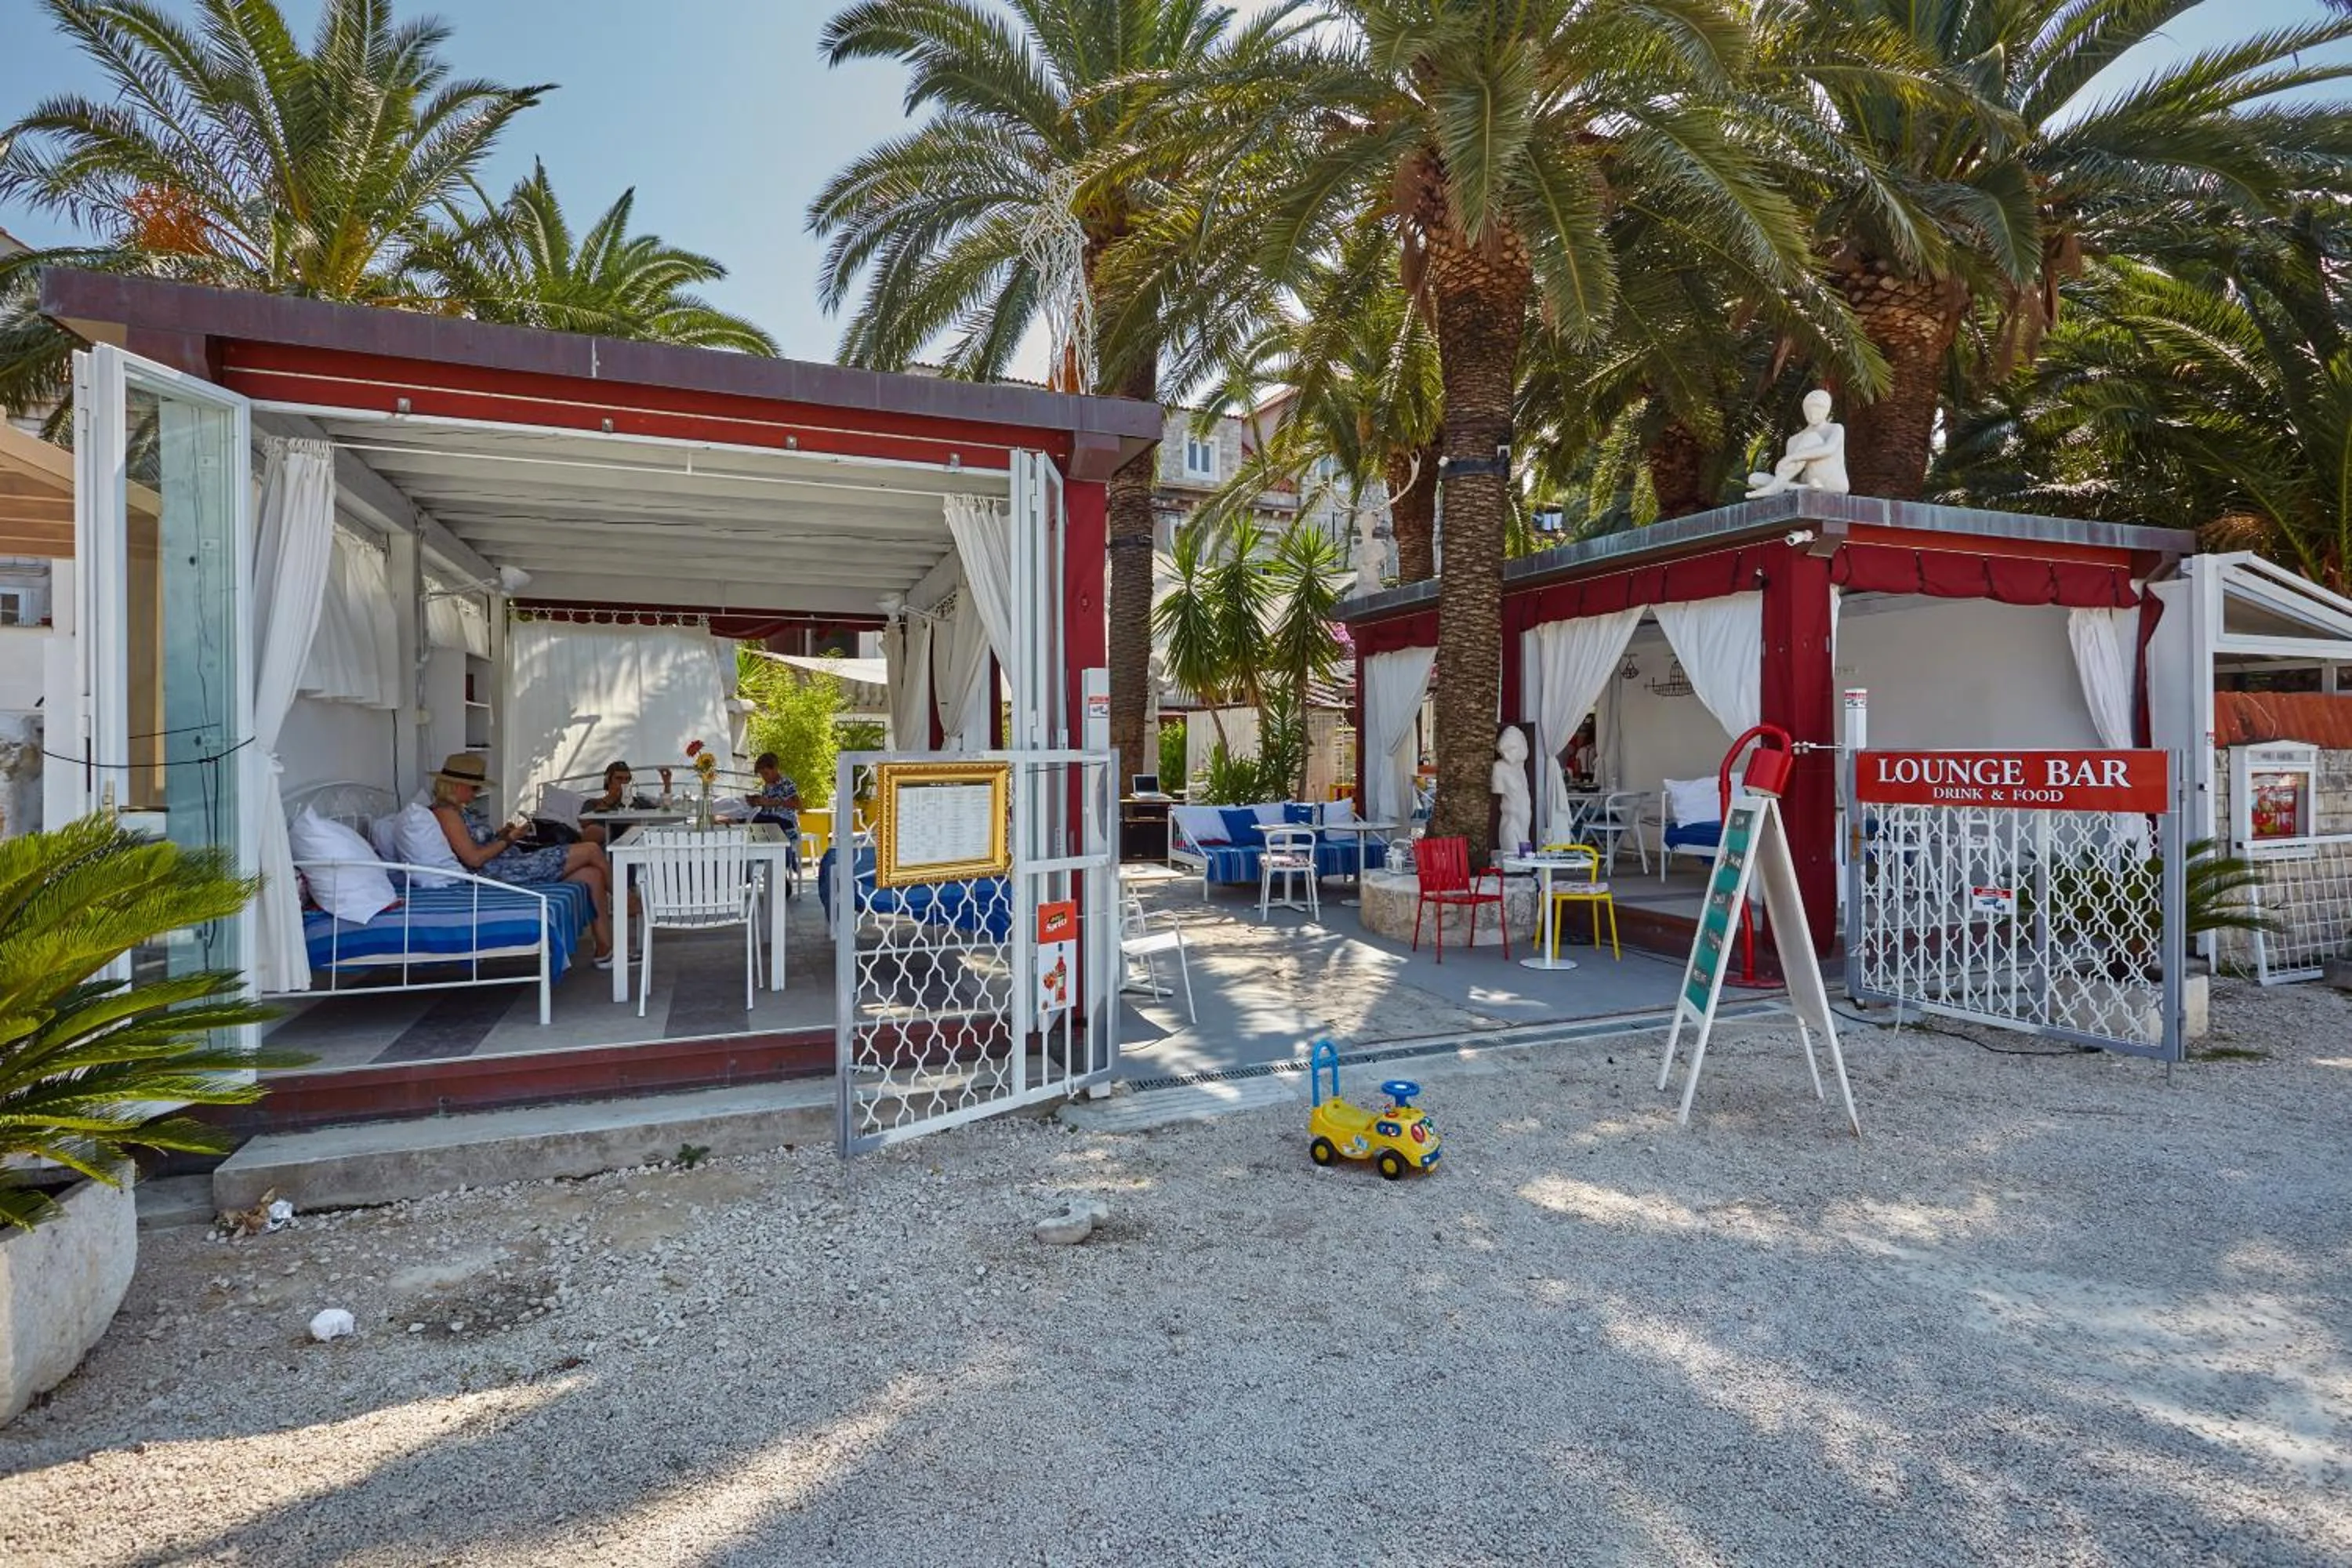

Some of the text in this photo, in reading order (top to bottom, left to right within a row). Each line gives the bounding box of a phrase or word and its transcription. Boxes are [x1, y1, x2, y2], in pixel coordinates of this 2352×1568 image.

[1878, 758, 2132, 788] LOUNGE BAR
[1933, 787, 2063, 802] DRINK & FOOD
